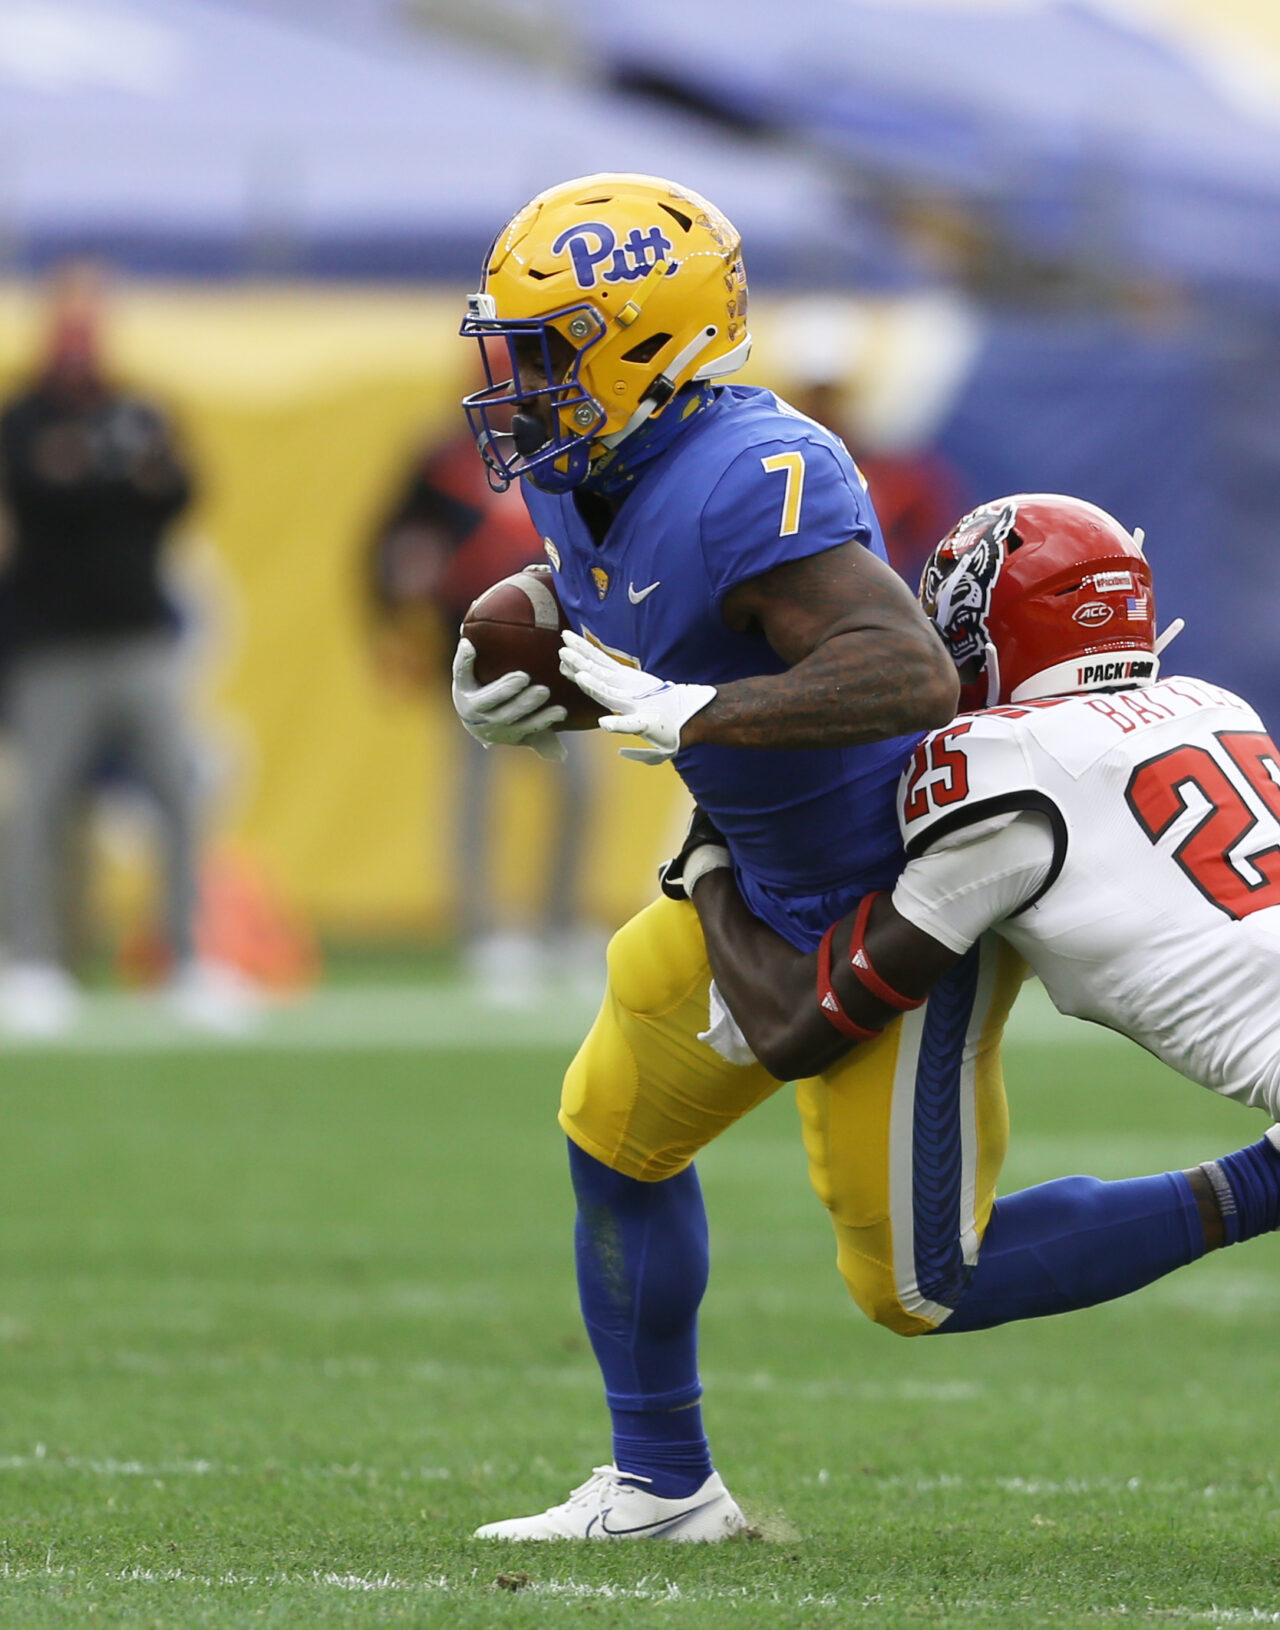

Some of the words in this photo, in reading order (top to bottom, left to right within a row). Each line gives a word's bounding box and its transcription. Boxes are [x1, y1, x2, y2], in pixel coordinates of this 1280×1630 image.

[552, 221, 679, 290] Pitt
[760, 450, 806, 538] 7
[1078, 606, 1109, 619] ACC
[904, 721, 974, 825] 25
